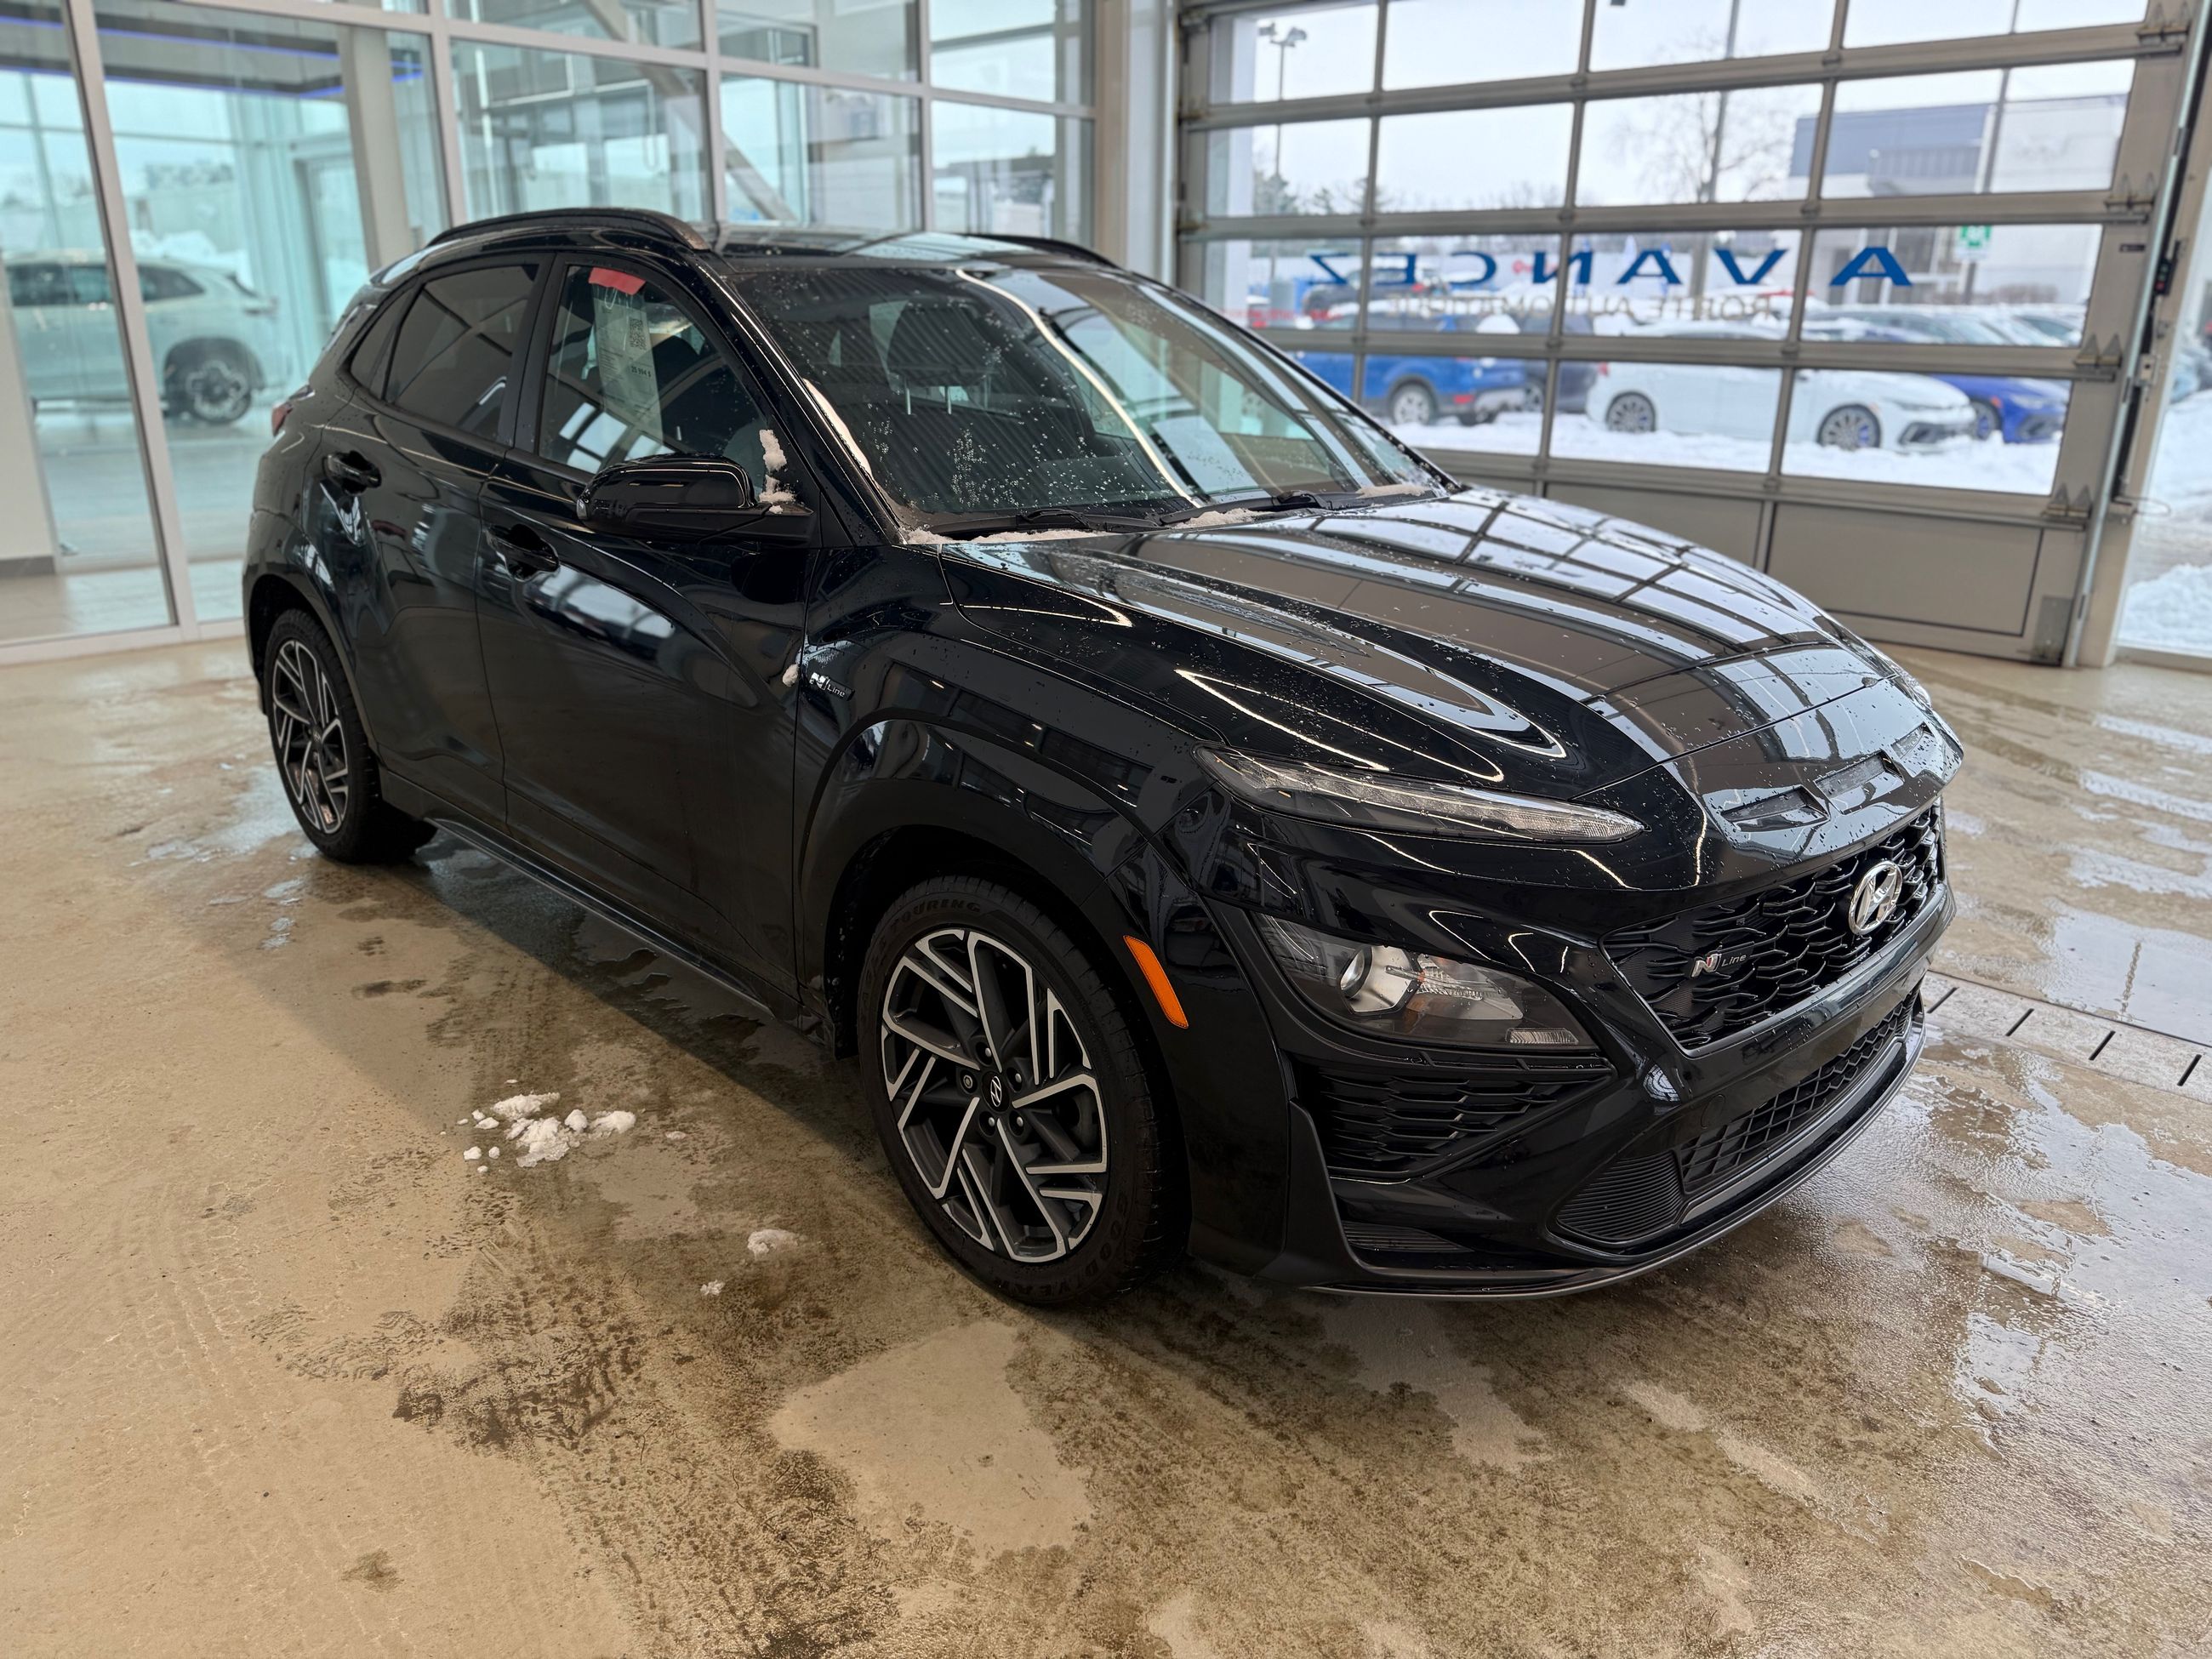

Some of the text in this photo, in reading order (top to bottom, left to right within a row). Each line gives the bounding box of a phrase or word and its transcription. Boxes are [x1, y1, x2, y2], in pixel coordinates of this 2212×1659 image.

[827, 684, 846, 698] Line
[890, 898, 981, 932] TOURING
[1721, 955, 1747, 967] Line
[994, 1193, 1129, 1297] GOODYEAR
